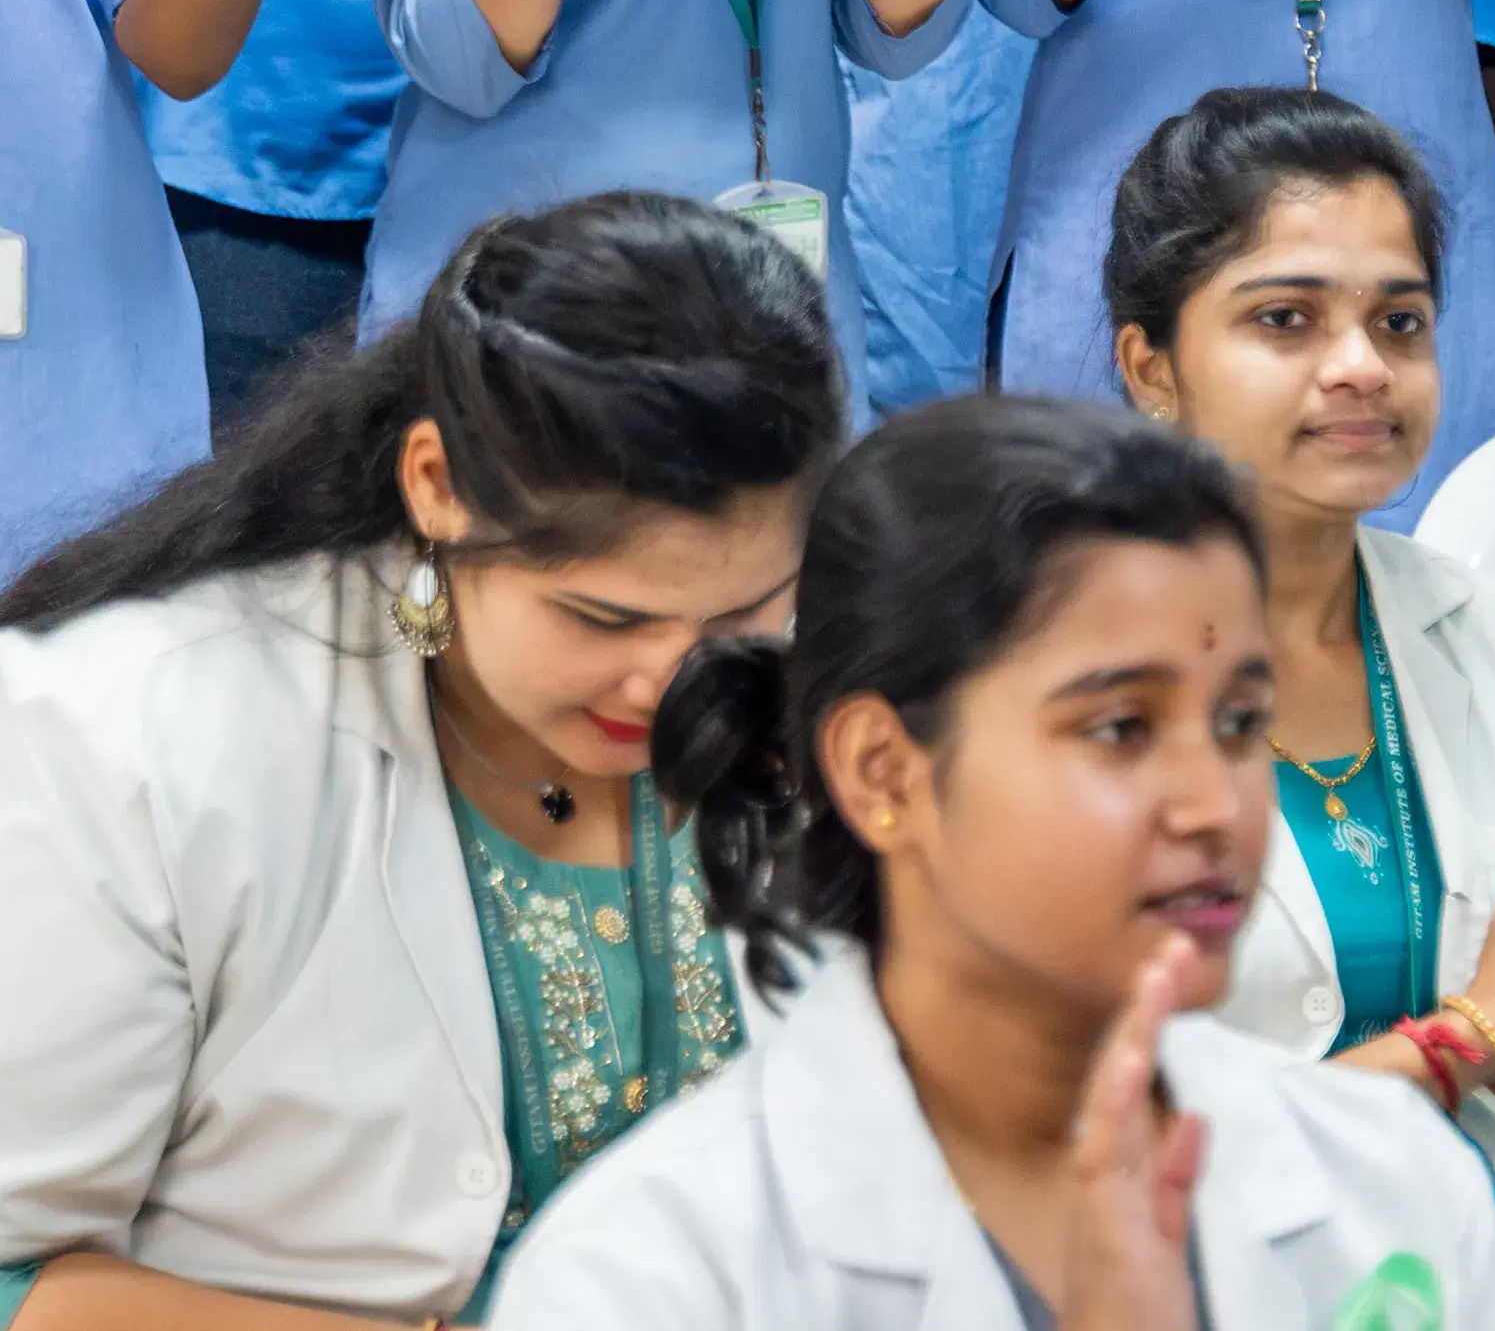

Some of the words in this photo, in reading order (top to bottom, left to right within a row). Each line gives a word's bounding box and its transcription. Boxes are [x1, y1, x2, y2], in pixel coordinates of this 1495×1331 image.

[1379, 680, 1401, 759] MEDICAL
[1392, 760, 1406, 785] OF
[1396, 788, 1419, 880] INSTITUTE
